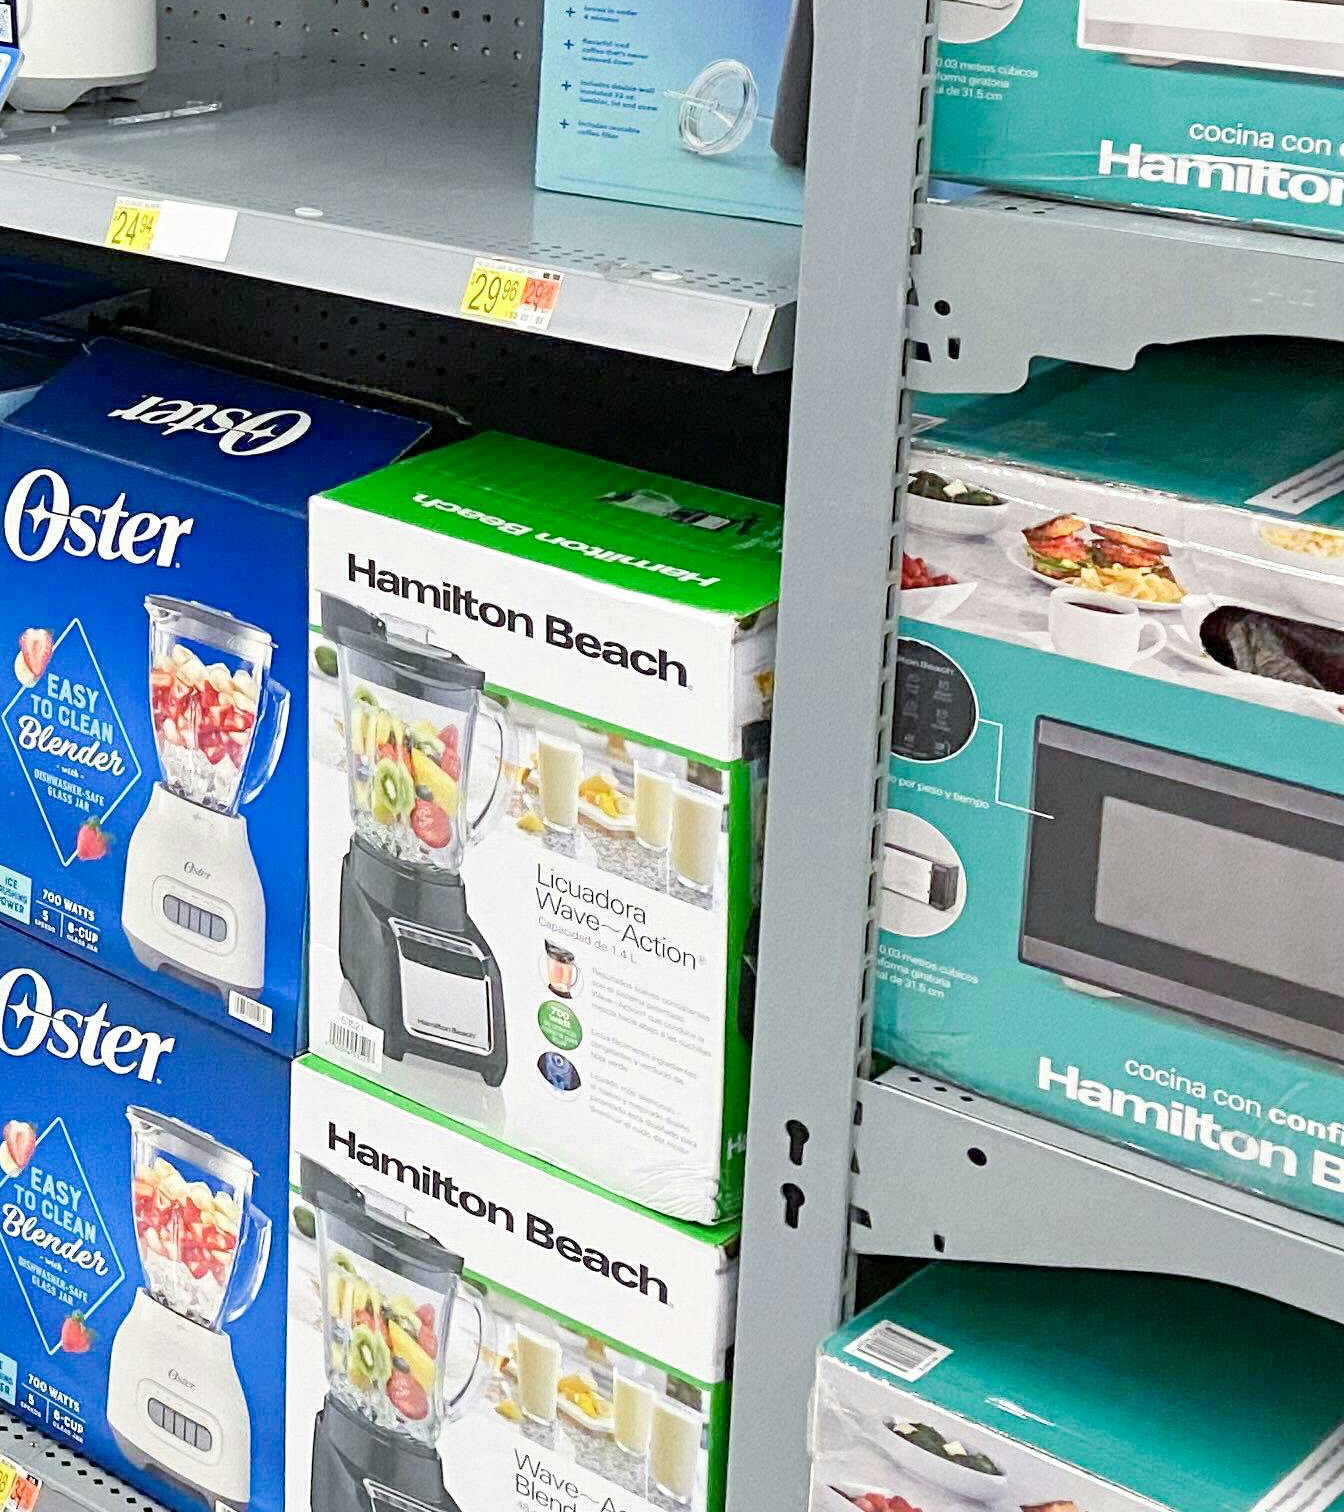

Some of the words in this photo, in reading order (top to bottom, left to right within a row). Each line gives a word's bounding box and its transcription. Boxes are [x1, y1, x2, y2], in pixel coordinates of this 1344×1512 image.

[1189, 122, 1274, 149] cocina
[1281, 134, 1332, 156] con
[108, 393, 314, 458] Oster
[3, 467, 195, 570] Oster
[411, 492, 531, 543] Beach
[550, 530, 723, 590] Hamilton
[346, 552, 535, 640] Hamilton
[544, 612, 690, 691] Beach
[45, 673, 100, 711] EASY
[30, 693, 55, 723] TO
[57, 701, 115, 745] CLEAN
[17, 714, 127, 780] Blender
[953, 791, 990, 810] tiempo
[182, 859, 212, 881] Oster
[536, 862, 647, 926] Licuadora
[42, 888, 62, 907] 700
[63, 898, 95, 922] WATTS
[537, 915, 592, 947] Capacidad
[549, 1004, 571, 1021] 700
[1124, 1059, 1207, 1099] cocina
[1213, 1089, 1261, 1117] con
[1037, 1054, 1299, 1178] Hamilton
[30, 1166, 83, 1206] EASY
[12, 1183, 38, 1212] TO
[41, 1198, 97, 1244] CLEAN
[327, 1119, 515, 1234] Hamilton
[525, 1211, 670, 1308] Beach
[0, 1201, 109, 1280] Blender
[58, 1289, 75, 1307] JAR
[28, 1373, 49, 1393] 700
[49, 1385, 81, 1414] WATTS
[167, 1367, 196, 1392] Oster
[53, 1409, 84, 1434] 6-CUP
